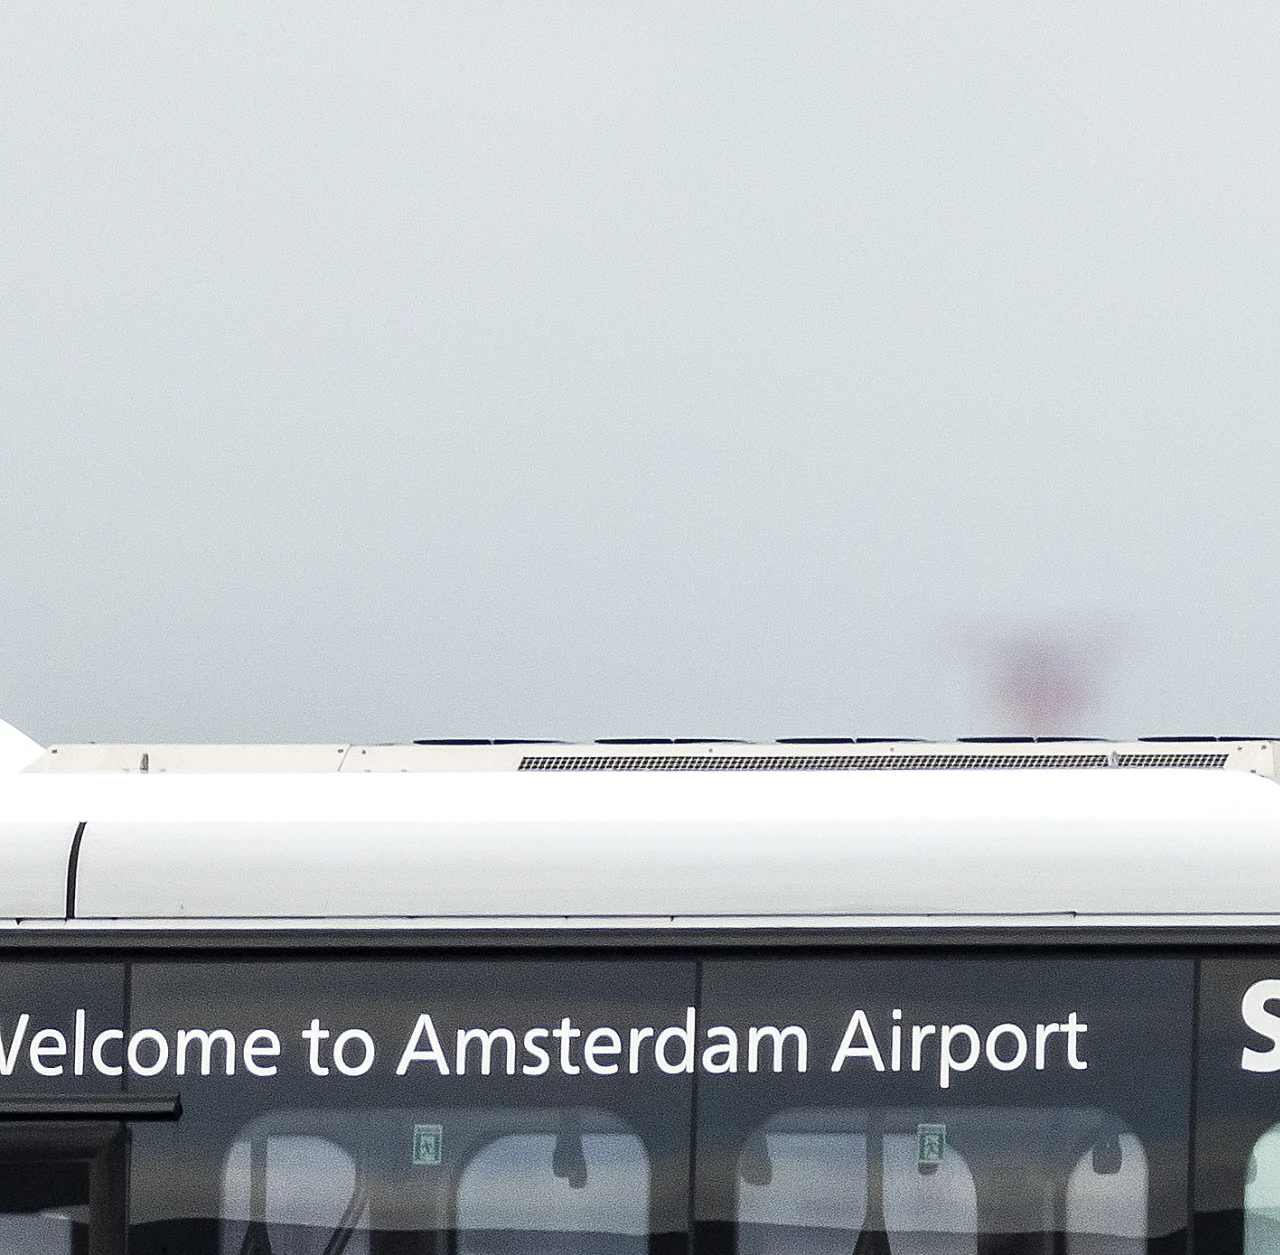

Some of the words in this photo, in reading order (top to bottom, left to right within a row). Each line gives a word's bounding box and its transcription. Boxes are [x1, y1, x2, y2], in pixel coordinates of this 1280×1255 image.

[301, 1018, 375, 1077] to
[395, 1006, 808, 1077] Amsterdam
[830, 1003, 1088, 1089] Airport
